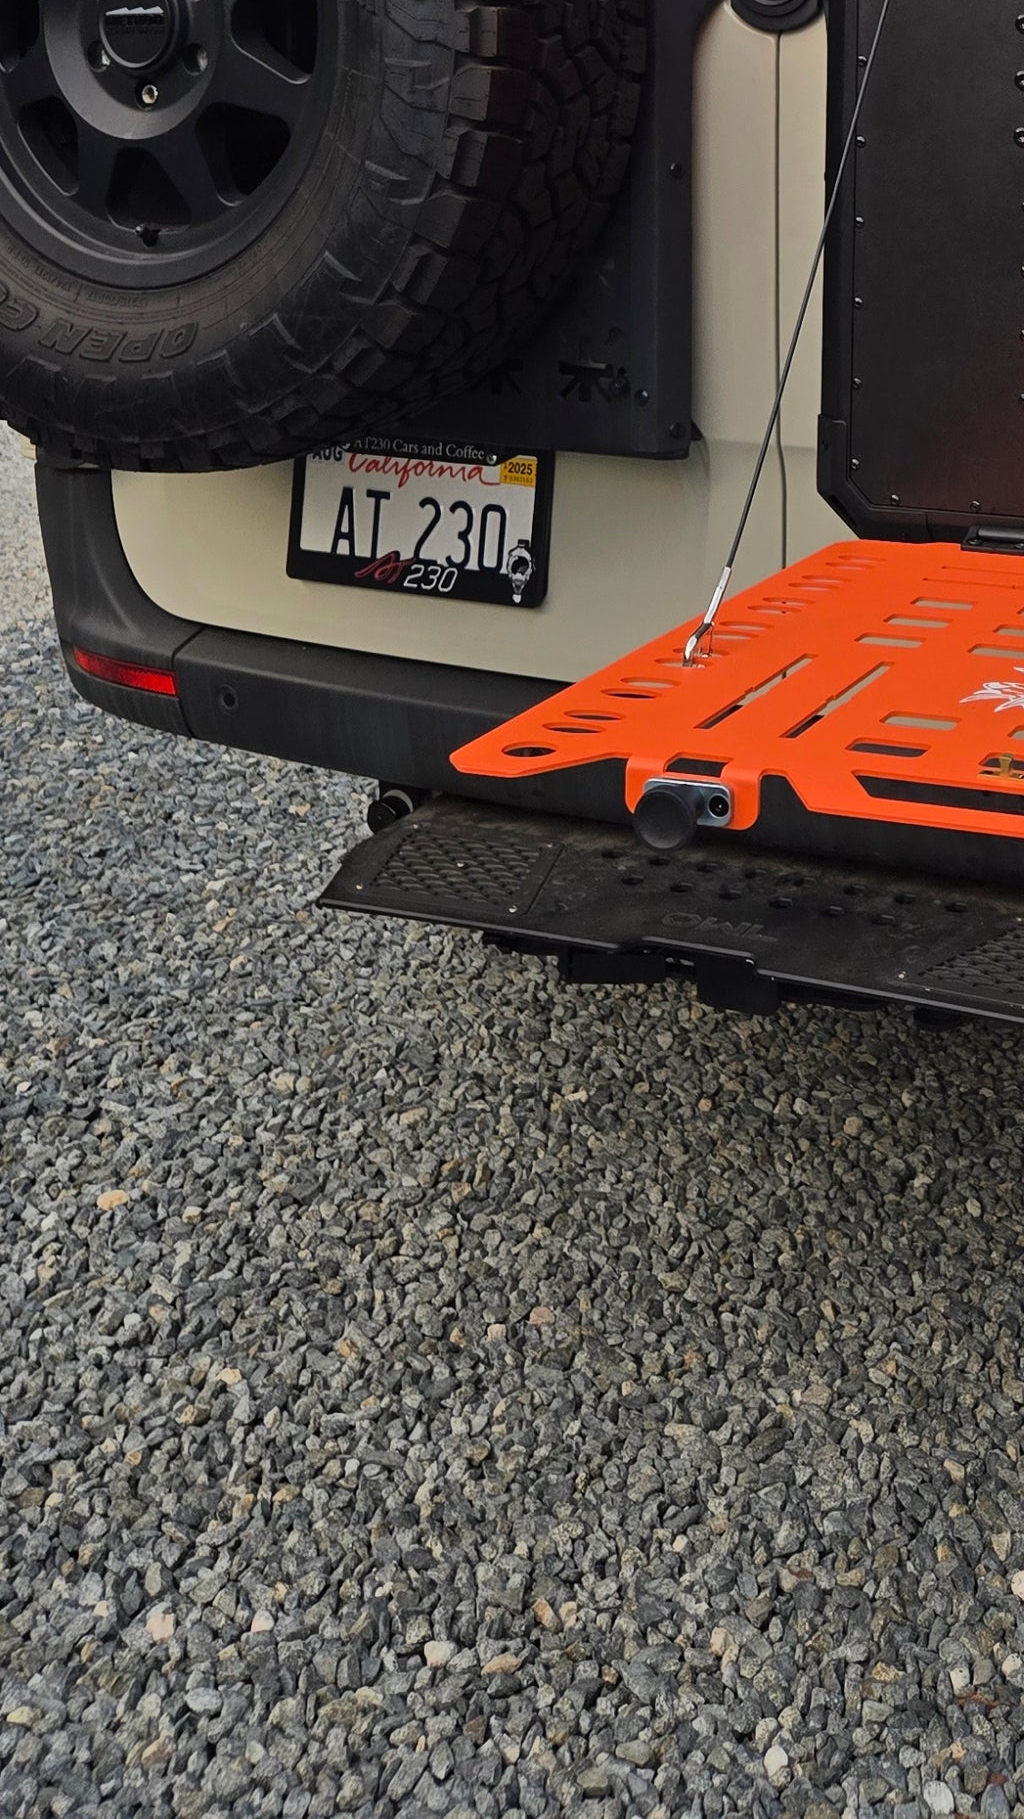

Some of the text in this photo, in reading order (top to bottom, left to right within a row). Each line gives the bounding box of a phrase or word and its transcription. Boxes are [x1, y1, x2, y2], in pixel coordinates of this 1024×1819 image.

[38, 317, 199, 364] OPEN
[392, 442, 419, 455] Cars
[421, 442, 442, 456] and
[446, 444, 485, 460] Coffee
[349, 451, 500, 488] California
[507, 461, 534, 476] 2025
[330, 486, 507, 571] AT 230
[403, 563, 458, 593] 230
